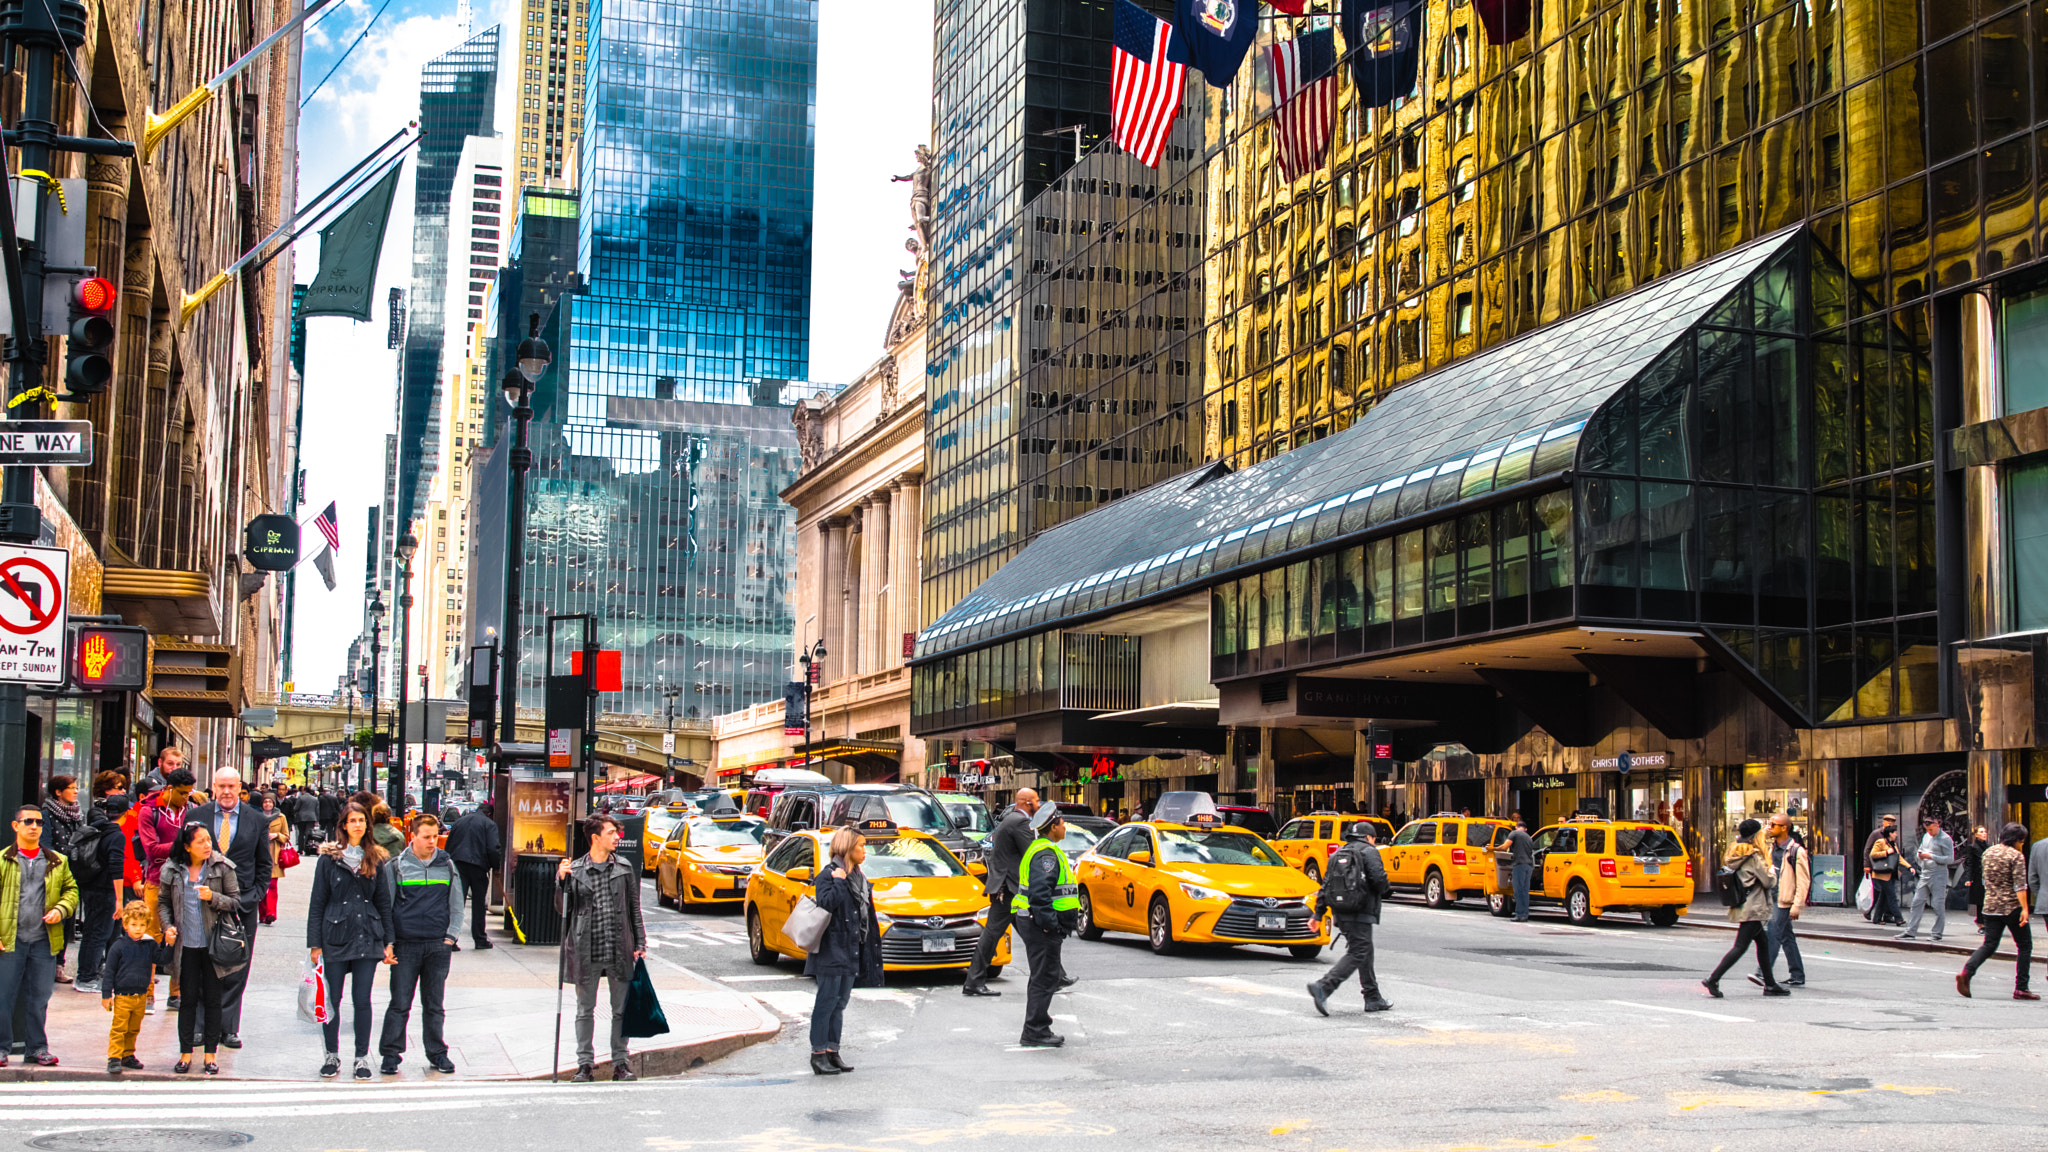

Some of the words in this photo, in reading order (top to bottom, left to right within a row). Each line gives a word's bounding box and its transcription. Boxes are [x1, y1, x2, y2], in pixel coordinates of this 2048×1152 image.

[309, 285, 364, 296] CIPRIANI
[0, 434, 25, 451] NE
[35, 434, 76, 451] WAY
[253, 546, 294, 554] CIPRIANI
[0, 640, 56, 658] AM-7PM
[0, 661, 18, 671] EPT
[23, 662, 57, 673] SUNDAY
[1304, 691, 1353, 704] GRAND
[1363, 695, 1407, 704] HYATT
[1591, 757, 1619, 768] CHRISTI
[1631, 755, 1665, 767] SOTHERS
[1876, 777, 1909, 788] CITIZEN
[518, 799, 564, 813] MARS
